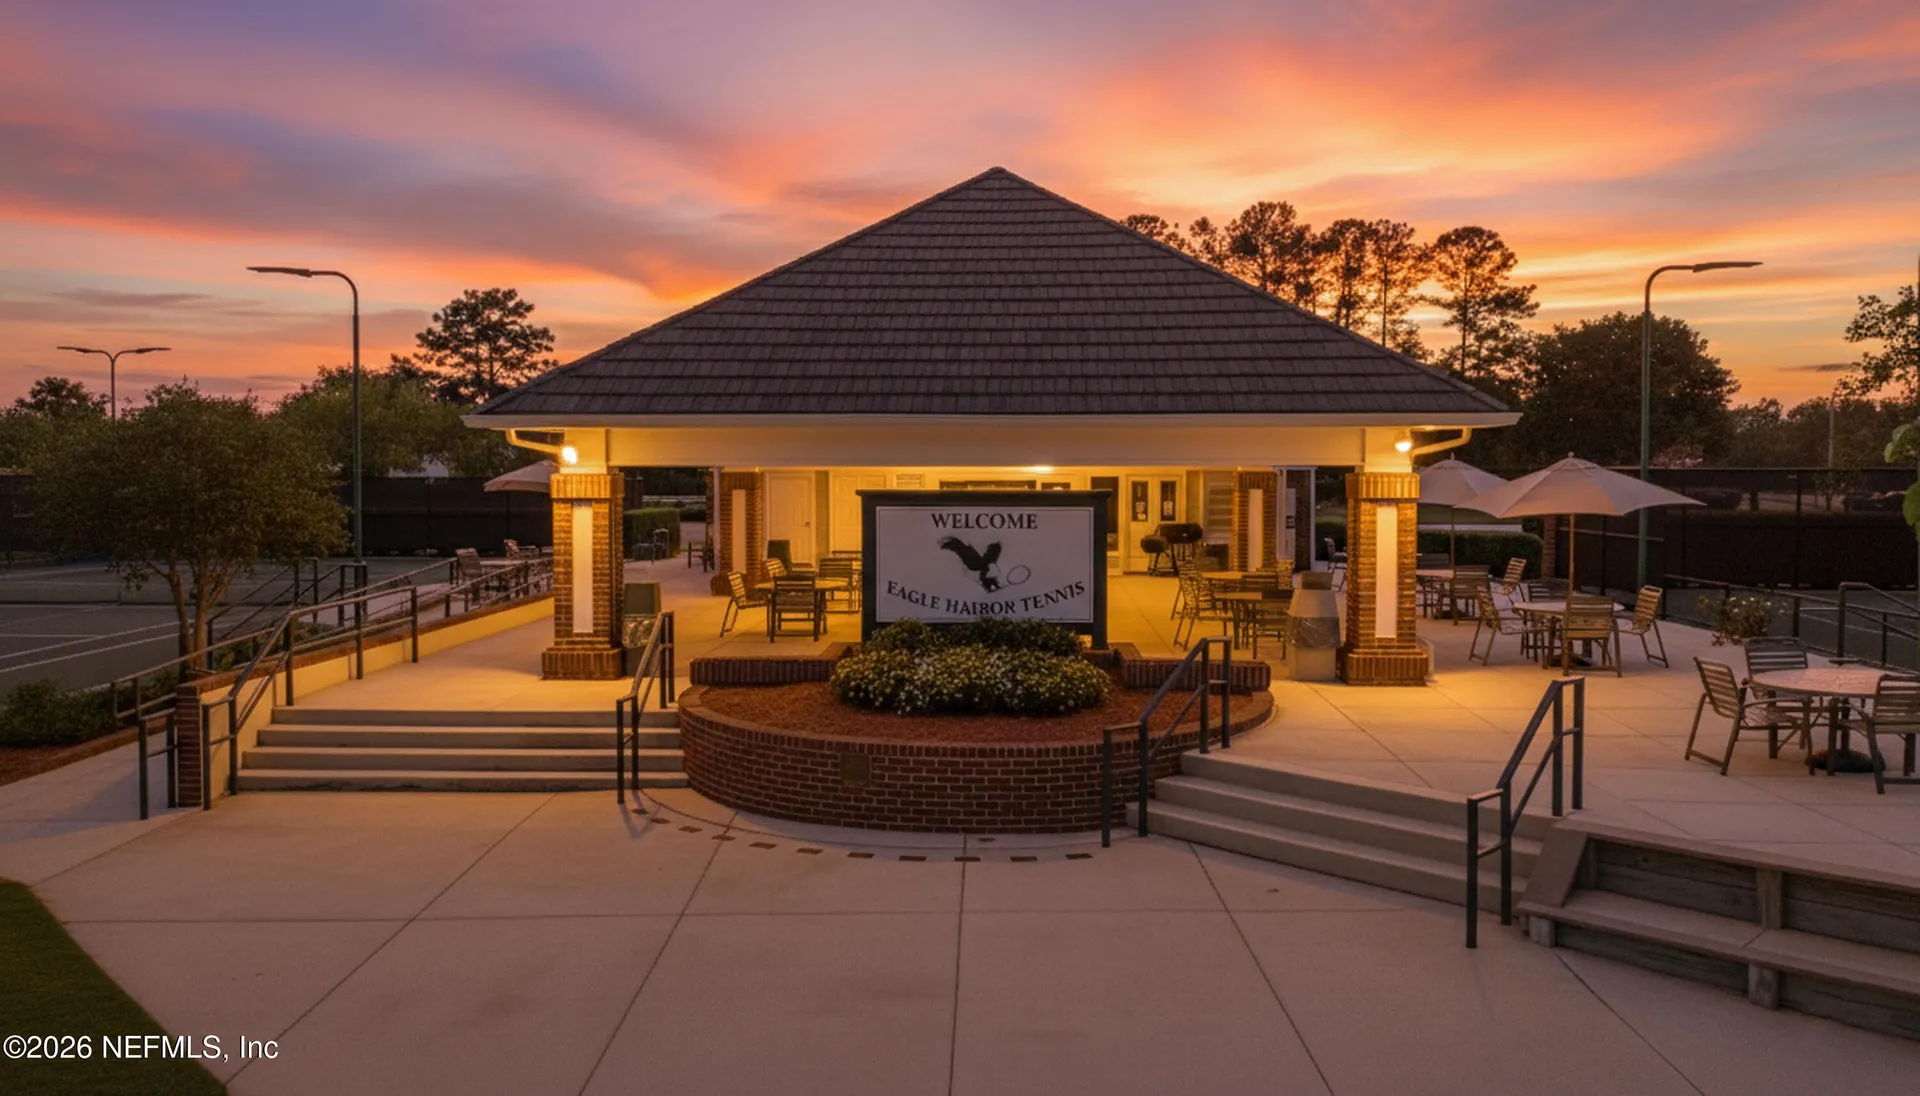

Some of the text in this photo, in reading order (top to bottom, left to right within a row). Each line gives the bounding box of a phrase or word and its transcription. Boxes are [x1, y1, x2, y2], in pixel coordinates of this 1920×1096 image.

[931, 513, 1038, 530] WELCOME
[887, 580, 941, 610] EAGLE
[1020, 580, 1085, 611] TENNIS
